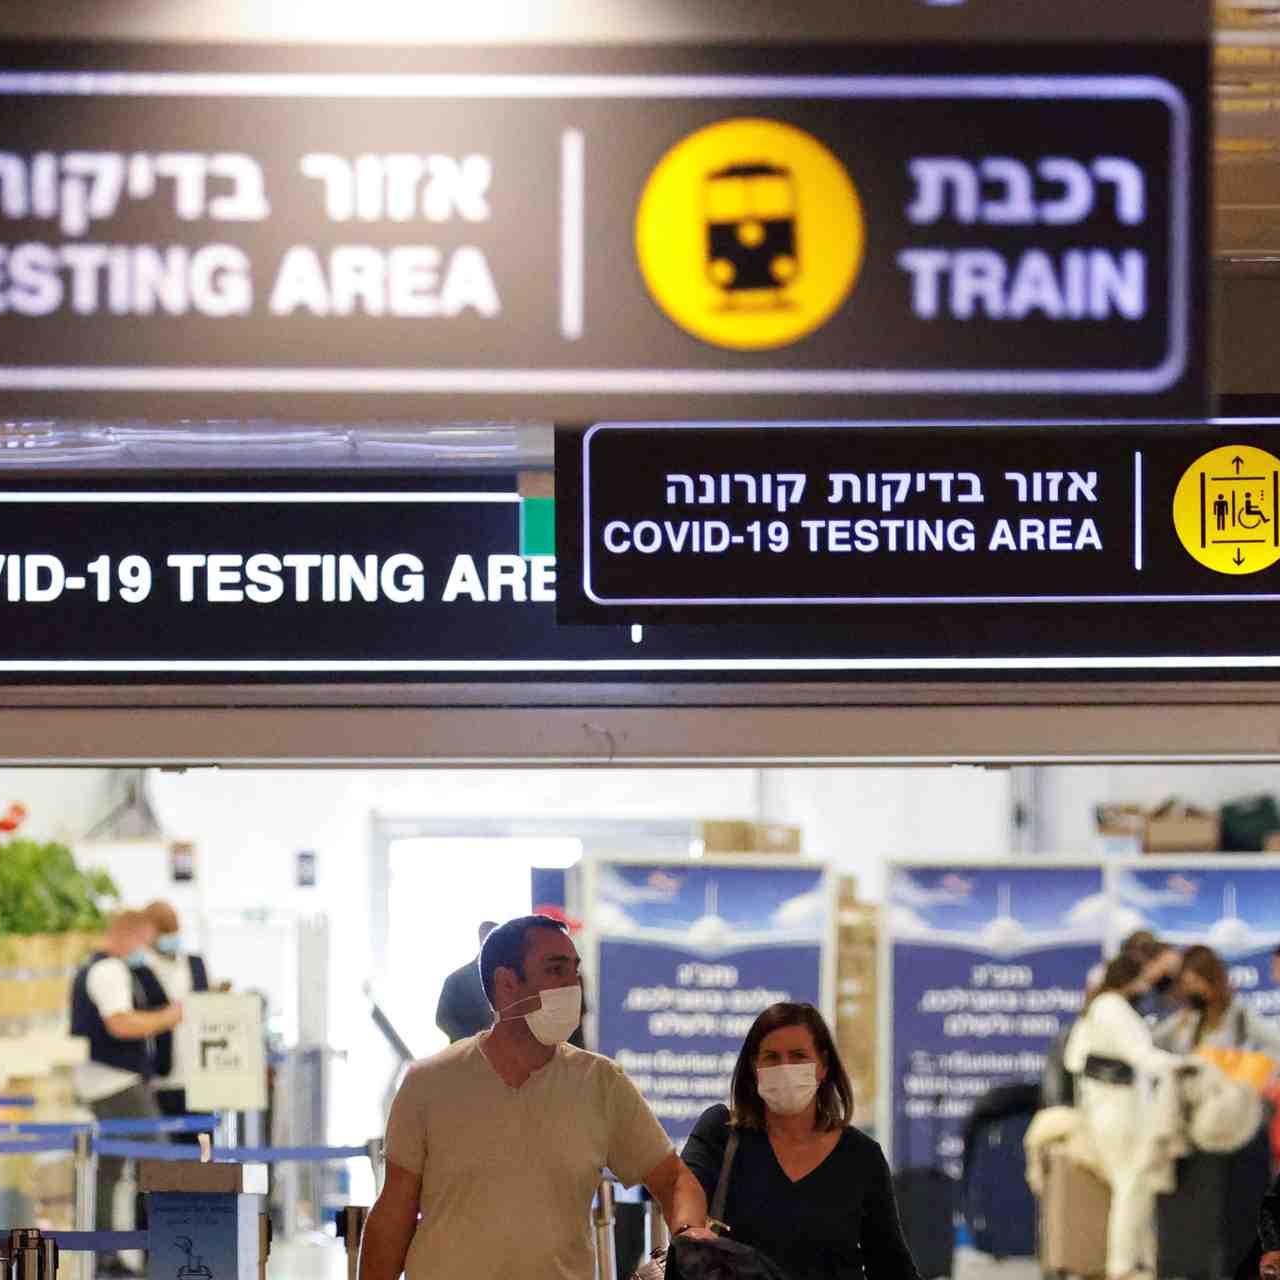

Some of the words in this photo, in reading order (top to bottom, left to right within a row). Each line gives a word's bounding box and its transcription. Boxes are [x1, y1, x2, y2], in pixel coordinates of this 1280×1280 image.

[301, 154, 492, 220] אזור
[906, 156, 1147, 225] רכבת
[269, 247, 500, 317] AREA
[898, 248, 1146, 321] TRAIN
[666, 473, 807, 514] קורונה
[828, 472, 985, 512] בדיקות
[1006, 471, 1097, 502] אזור
[603, 520, 789, 554] COVID-19
[801, 518, 976, 553] TESTING
[988, 518, 1104, 552] AREA
[167, 553, 425, 603] TESTING
[441, 554, 556, 602] ARE
